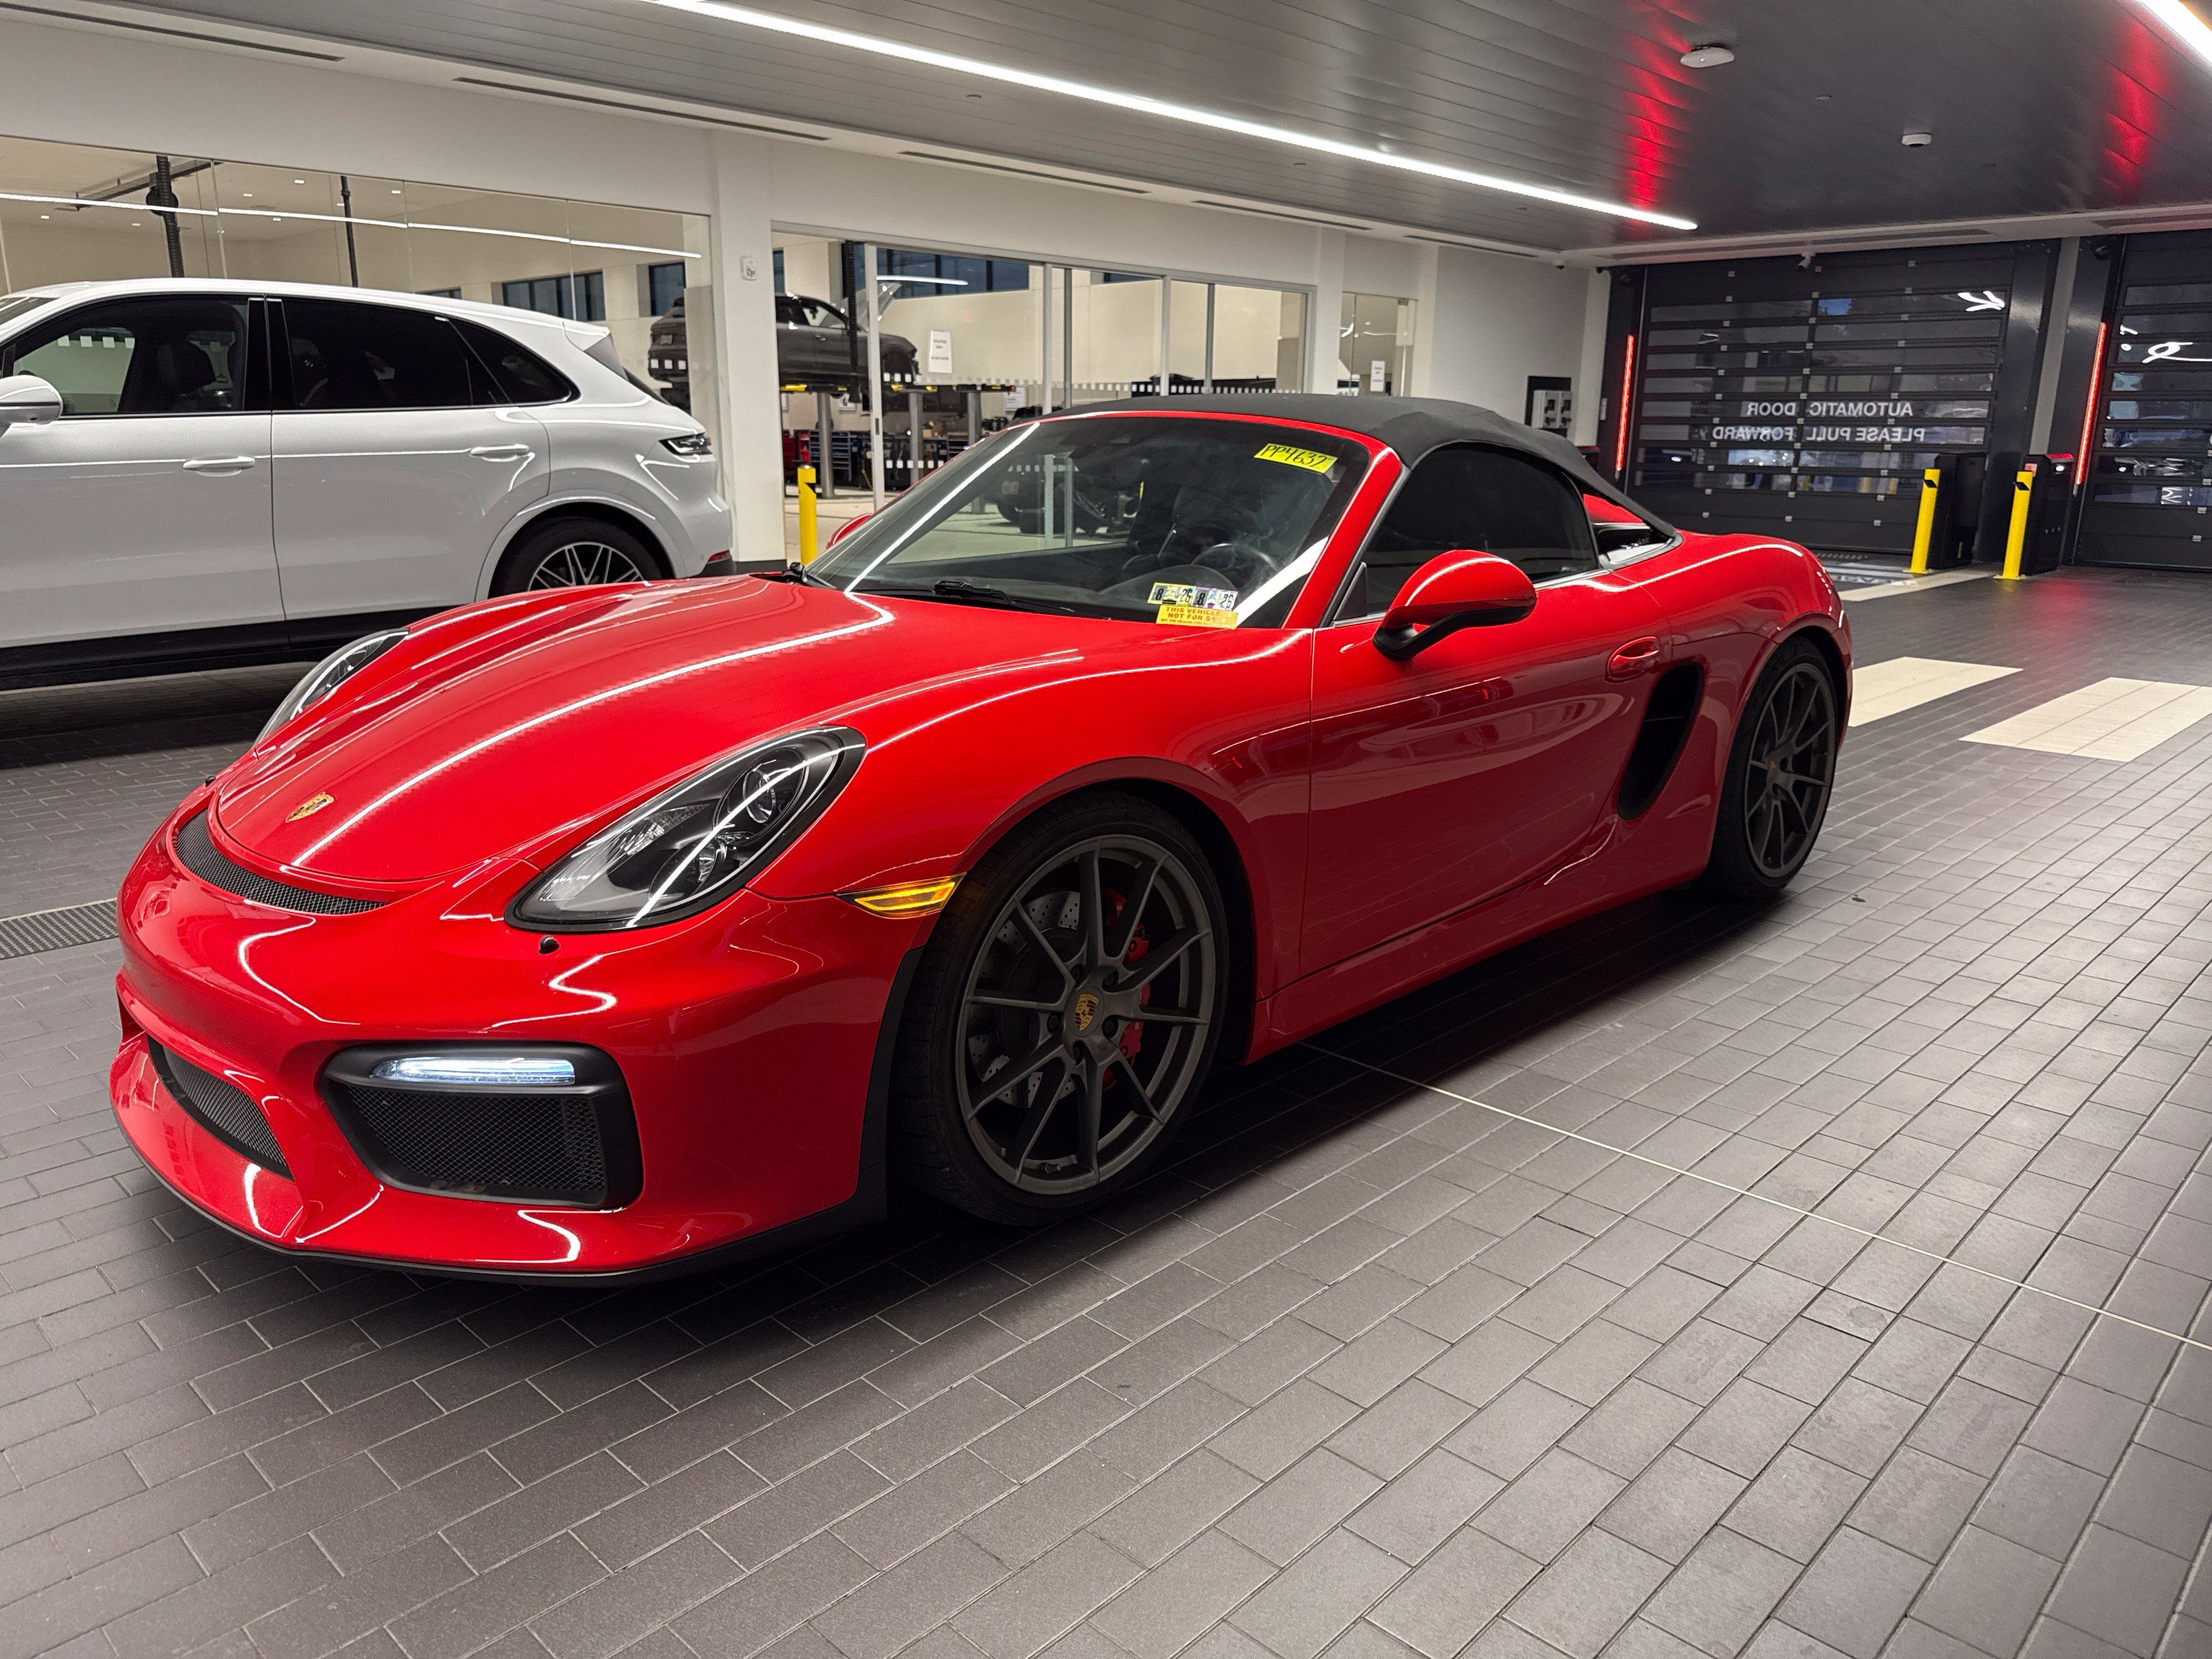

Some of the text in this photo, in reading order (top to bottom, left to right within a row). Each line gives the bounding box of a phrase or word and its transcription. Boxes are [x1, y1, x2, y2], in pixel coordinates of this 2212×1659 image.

[1155, 588, 1193, 603] 8 26
[1197, 593, 1206, 605] 8
[1187, 608, 1222, 617] VEHICLE
